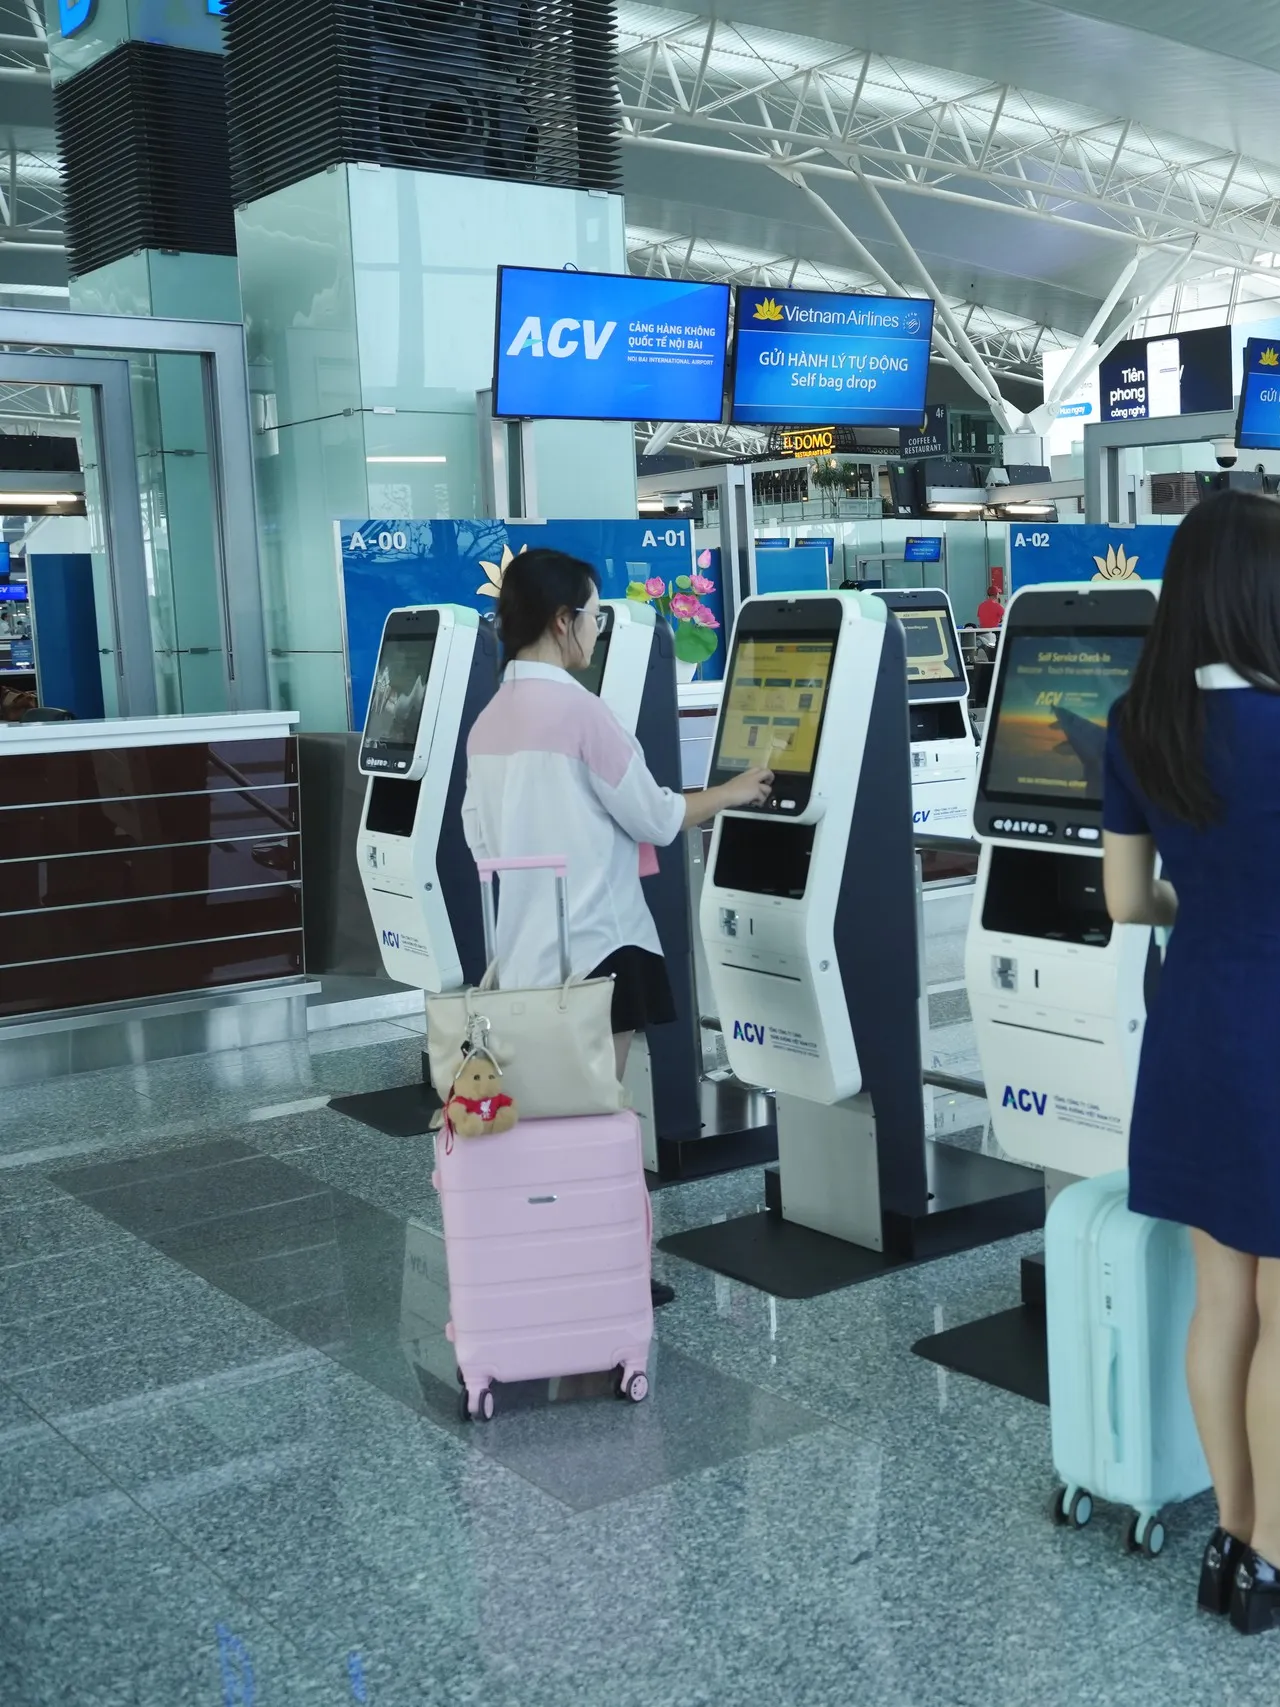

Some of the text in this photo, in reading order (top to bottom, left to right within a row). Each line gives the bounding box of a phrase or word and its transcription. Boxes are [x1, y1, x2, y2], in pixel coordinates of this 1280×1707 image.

[784, 305, 899, 328] Vietnam Airlines
[506, 316, 617, 360] ACV
[629, 322, 715, 337] CẢNG HÀNG KHÔNG
[628, 335, 703, 351] QUỐC TẾ NỘI BÀI
[649, 357, 690, 365] INTERNATIONAL
[759, 348, 909, 374] GỬI HÀNH LÝ TỰ ĐỘNG
[791, 372, 877, 392] Self bag drop
[1122, 367, 1145, 384] Tiên
[1110, 387, 1145, 406] phong
[1260, 387, 1276, 402] GỬI
[1111, 405, 1146, 418] công nghệ
[783, 432, 832, 450] EL DOMO
[904, 443, 942, 455] RESTAURANT
[908, 436, 930, 446] COFFEE
[350, 531, 407, 551] A-00
[642, 530, 685, 548] A-01
[1014, 533, 1050, 547] A-02
[1052, 652, 1077, 662] Service
[1079, 652, 1111, 662] Check-In
[913, 810, 930, 823] CV
[382, 930, 399, 949] ACV
[733, 1020, 764, 1045] ACV
[1002, 1085, 1047, 1116] ACV
